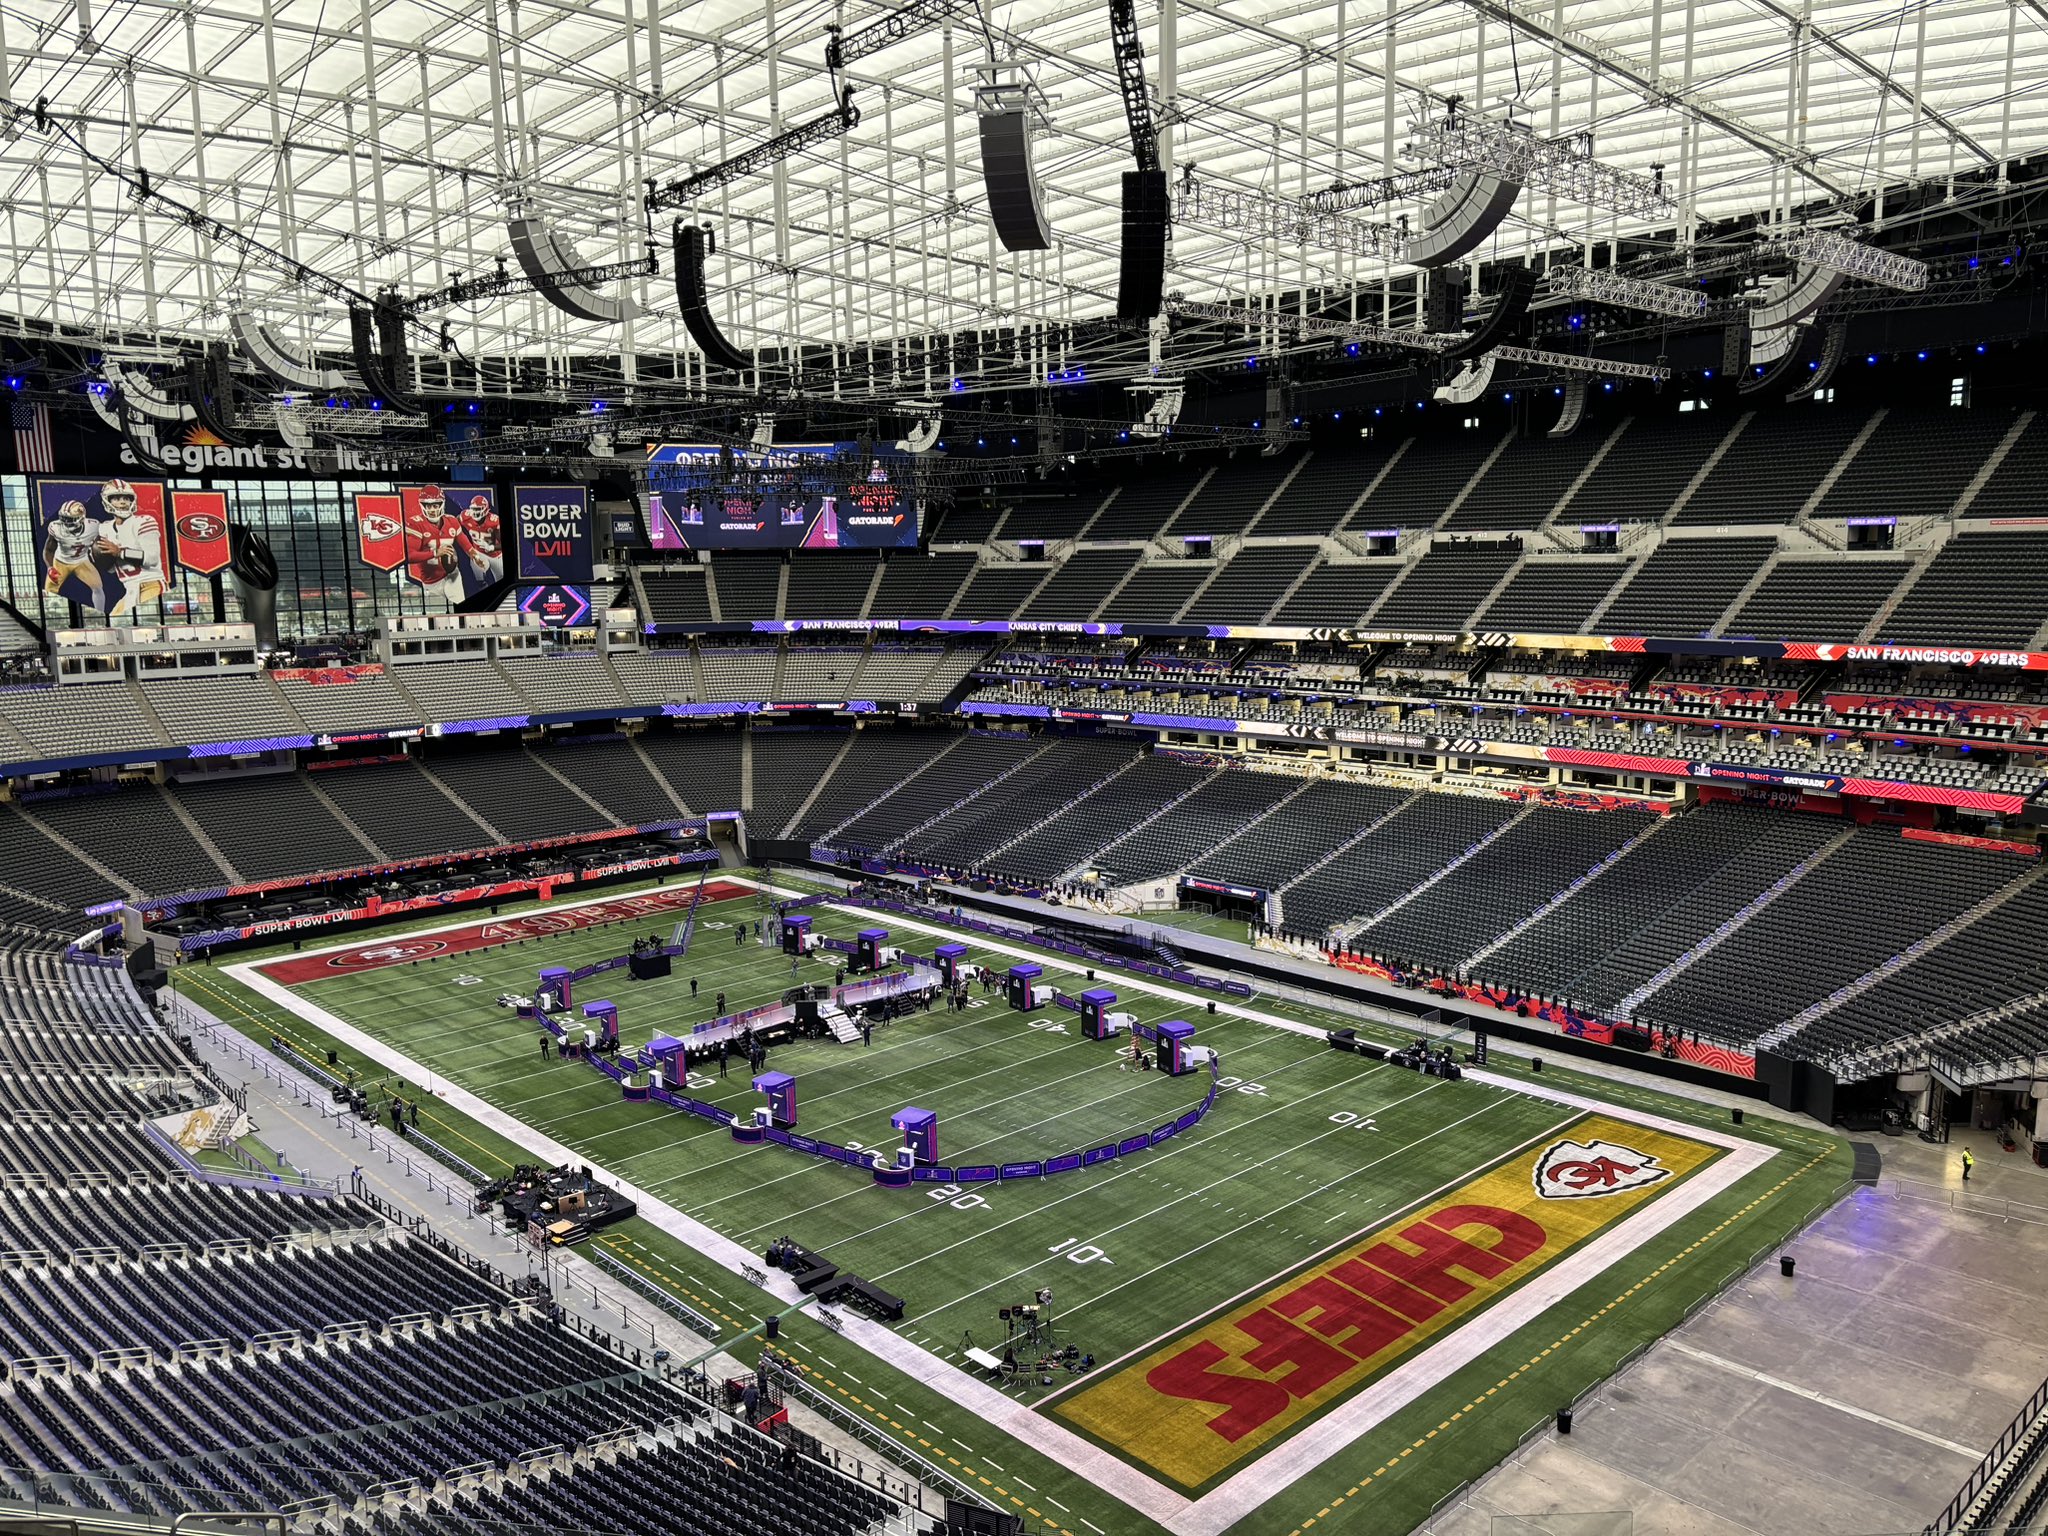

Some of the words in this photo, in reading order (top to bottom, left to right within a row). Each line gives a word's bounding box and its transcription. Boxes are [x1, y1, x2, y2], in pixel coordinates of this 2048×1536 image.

[676, 452, 761, 467] OPENG
[520, 504, 582, 521] SUPER
[849, 517, 893, 525] GATORADE
[523, 522, 582, 538] BOWL
[70, 544, 85, 557] 7
[534, 541, 572, 556] LVIII
[824, 621, 871, 629] FRANCISCO
[874, 621, 899, 630] 49ERS
[1009, 622, 1037, 631] KANSAS
[1039, 623, 1056, 632] CITY
[1058, 623, 1083, 632] CHIEFS
[1357, 632, 1390, 640] WELCOME
[1403, 633, 1433, 641] OPENING
[1435, 634, 1457, 642] NIGHT
[1847, 647, 1878, 660] SAN
[1882, 649, 1975, 663] FRANCISCO
[1980, 652, 2029, 667] 49ERS
[900, 703, 917, 711] 1:37
[332, 734, 360, 743] OPENING
[1117, 728, 1137, 737] BOWL
[1335, 731, 1366, 740] WELCOME
[1367, 733, 1375, 741] TO
[1377, 734, 1405, 744] OPENING
[1406, 736, 1427, 745] NIGHT
[1712, 769, 1745, 779] OPENING
[1747, 771, 1770, 782] NIGHT
[1783, 776, 1826, 788] GATORADE
[1732, 788, 1766, 799] SUPER
[1772, 792, 1806, 804] BOWL
[597, 866, 624, 877] SUPER
[627, 861, 651, 873] BOWL
[653, 857, 669, 867] LVIII
[481, 890, 715, 940] 49ERS
[255, 923, 291, 936] SUPER
[295, 917, 329, 929] BOWL
[332, 911, 352, 922] LVIII
[1216, 1076, 1267, 1094] 20
[1328, 1111, 1377, 1129] 10
[1546, 1156, 1641, 1191] KC
[926, 1184, 986, 1210] 20
[1048, 1237, 1105, 1264] 10
[1146, 1204, 1547, 1444] CHIEFS
